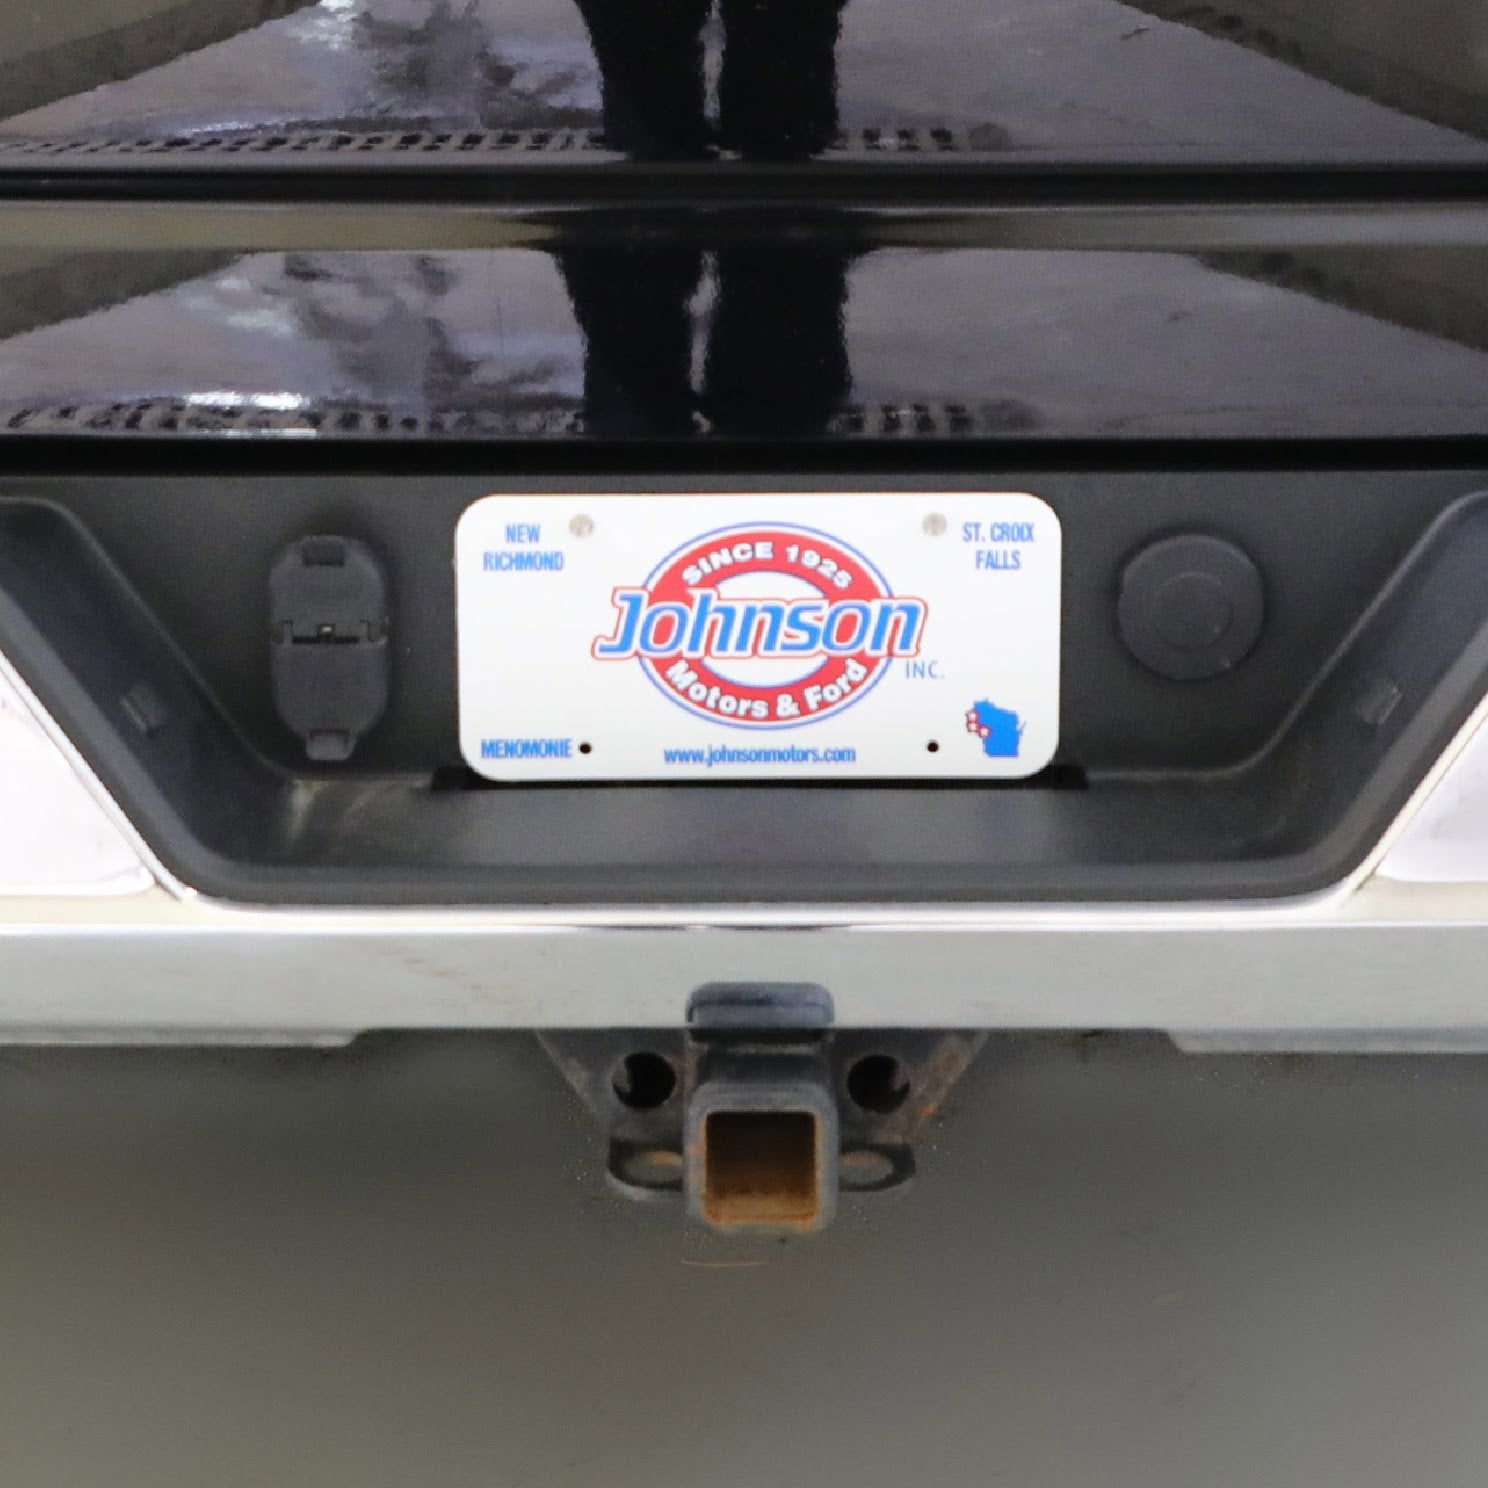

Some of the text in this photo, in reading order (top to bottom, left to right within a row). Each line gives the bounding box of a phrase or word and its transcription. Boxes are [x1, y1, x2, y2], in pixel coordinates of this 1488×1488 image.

[505, 523, 541, 543] NEW
[962, 521, 1035, 542] ST. CROIX
[483, 550, 565, 571] RICHMOND
[681, 541, 854, 589] SINCE 1925
[975, 549, 1021, 570] FALLS
[596, 591, 924, 655] Johnson
[905, 660, 946, 681] INC.
[665, 657, 868, 719] Motors & Ford
[480, 738, 574, 759] MENOMONIE
[664, 743, 857, 769] www.johnsonmotors.com
